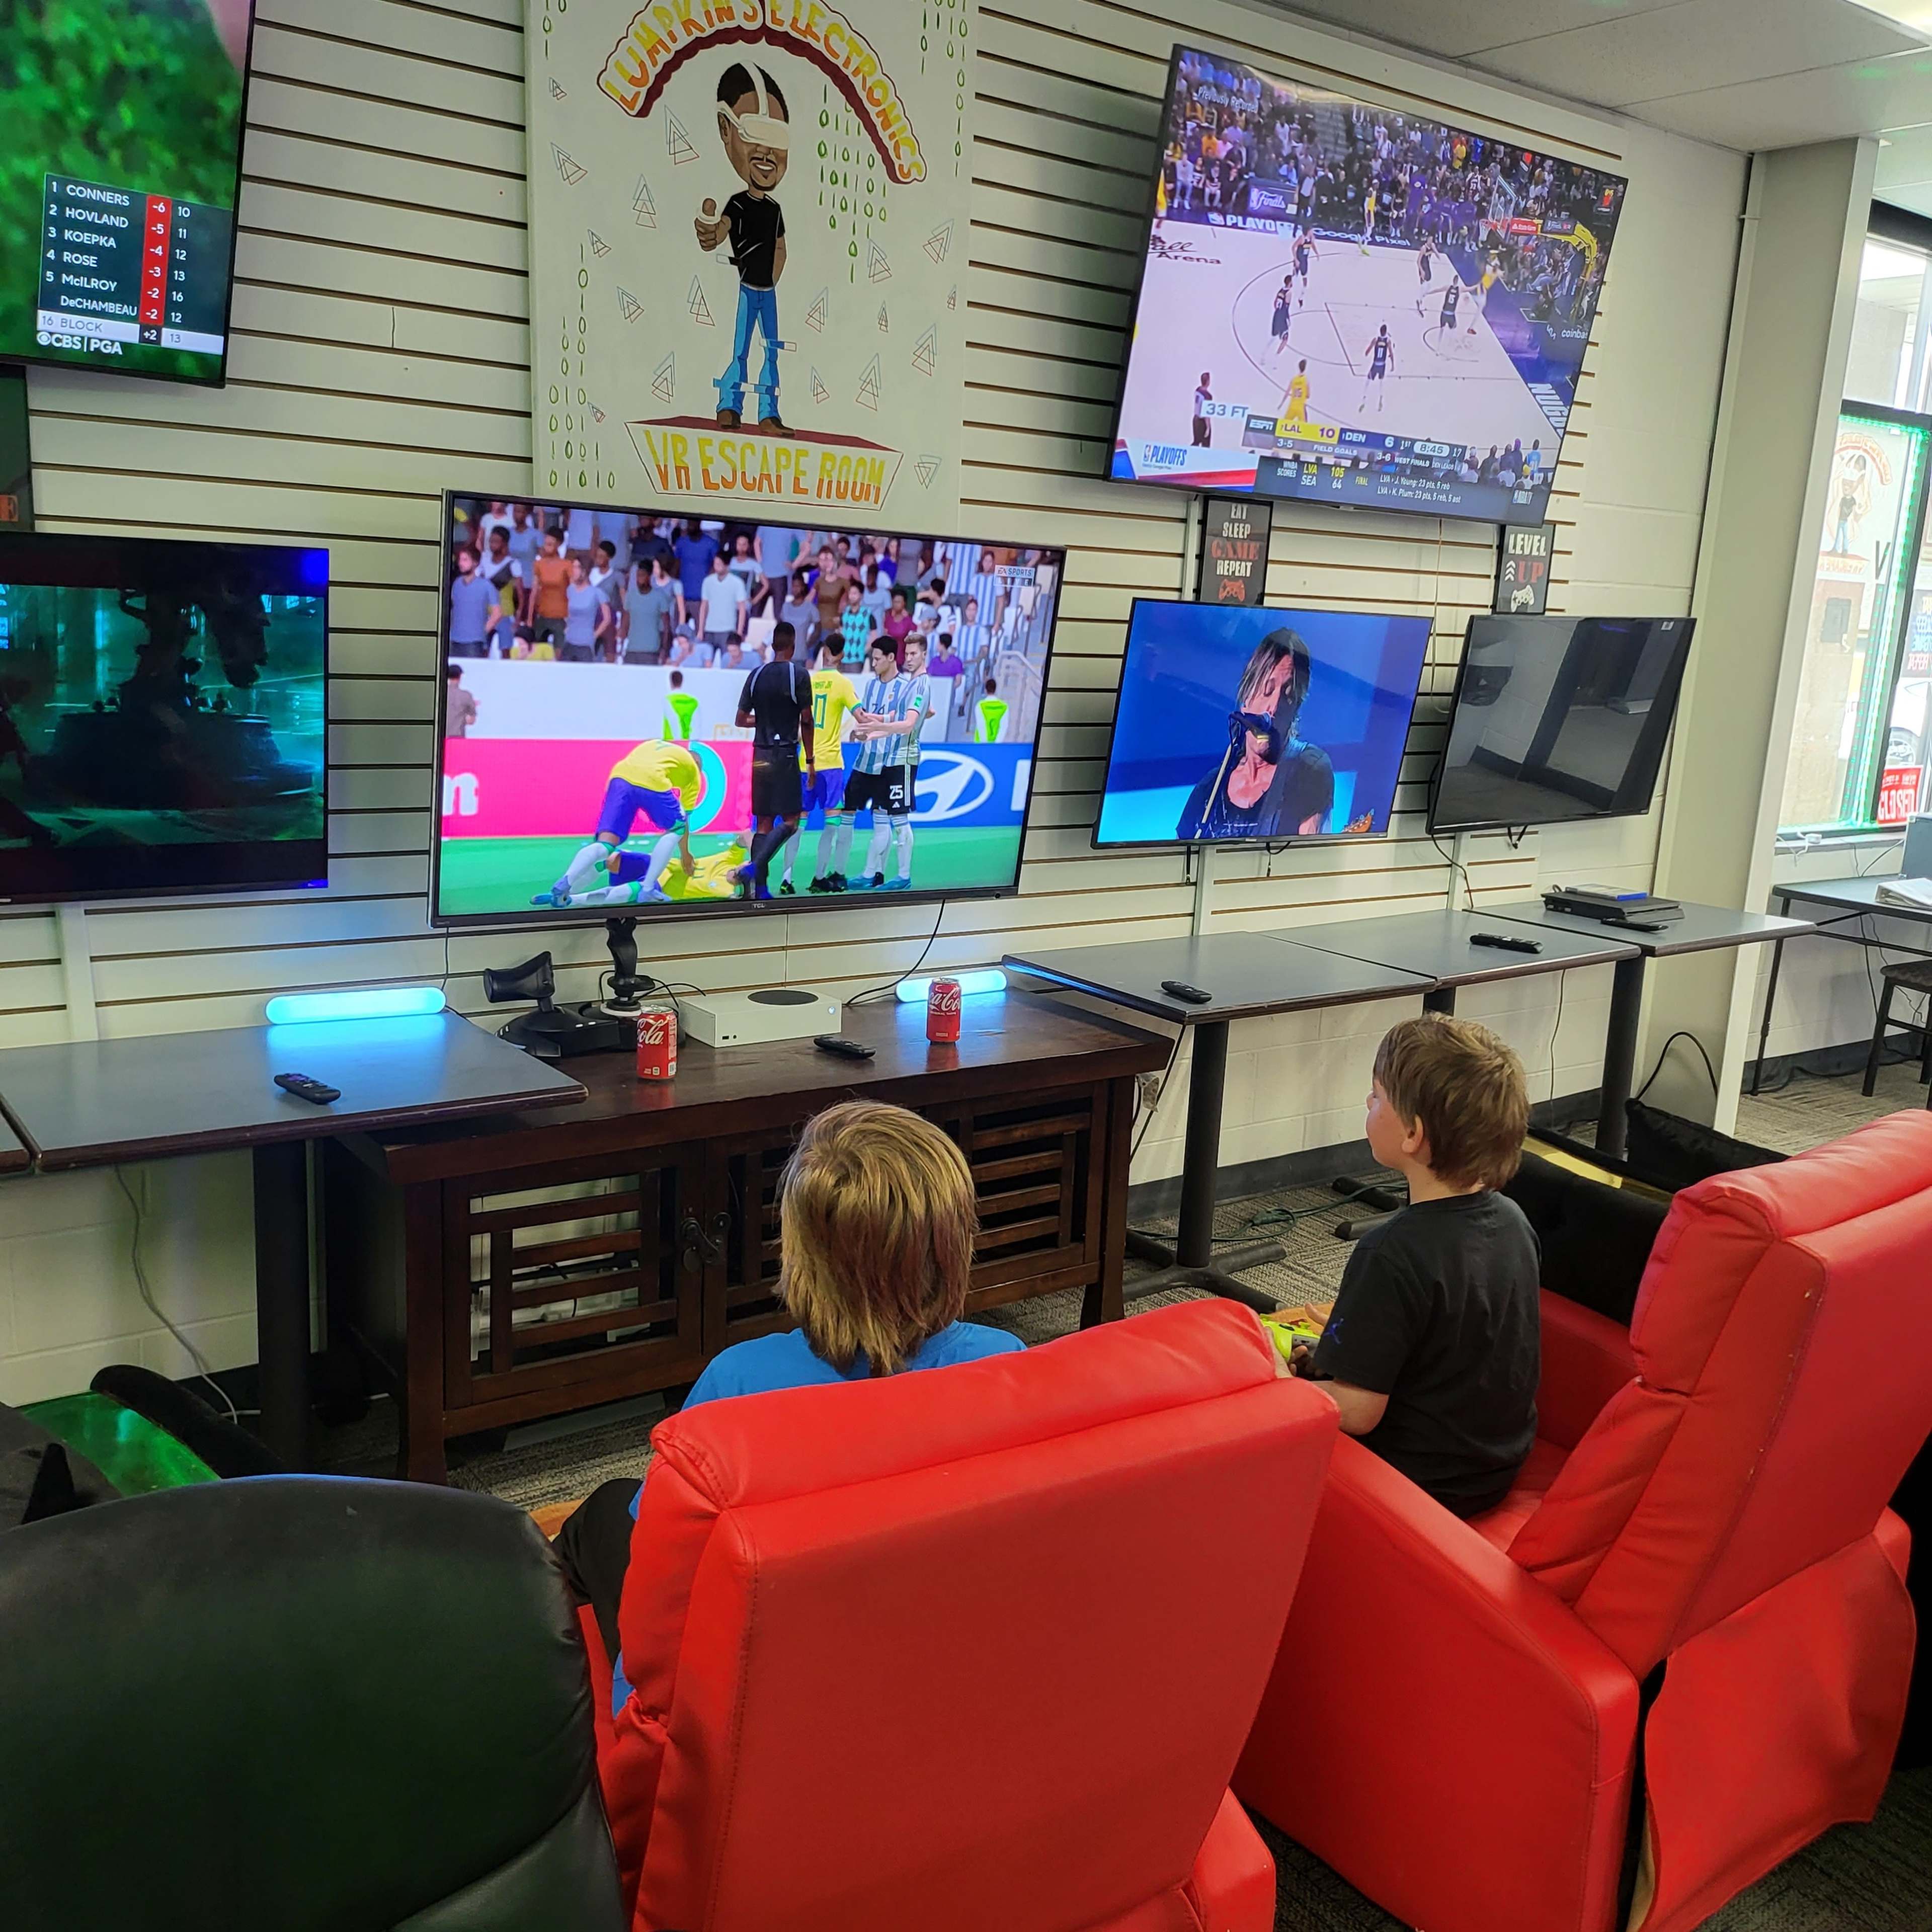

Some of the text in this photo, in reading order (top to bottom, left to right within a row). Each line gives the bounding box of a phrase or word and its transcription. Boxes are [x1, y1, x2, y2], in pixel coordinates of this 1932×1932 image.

[52, 181, 190, 217] 1 CONNERS -6 10
[49, 204, 187, 239] 2 HOVLAND -5 11
[48, 227, 187, 261] 3 KOEPKA -4 12
[1375, 235, 1411, 246] Pixel
[46, 250, 185, 281] 4 ROSE -3 13
[1157, 252, 1222, 264] Arena
[46, 271, 184, 302] 5 McILROY -2 16
[60, 295, 182, 323] DeCHAMBEAU -2 12
[42, 315, 181, 344] 16 BLOCK +2 13
[1206, 404, 1249, 417] 33 FT
[1249, 419, 1273, 430] ESPN
[1283, 423, 1302, 433] LAL
[1319, 428, 1335, 438] 10
[1277, 439, 1293, 448] 3-5
[1334, 447, 1357, 455] GOALS
[1345, 432, 1365, 442] DEN
[1385, 437, 1394, 447] 6
[1420, 444, 1443, 454] 8:45
[1453, 448, 1462, 457] 17
[1150, 445, 1187, 466] PLAYOFFS
[1377, 453, 1391, 461] 3-6
[1410, 459, 1429, 467] FINALS
[644, 429, 886, 505] VR ESCAPE ROOM
[1283, 461, 1345, 477] WNBA LVA 105
[1277, 468, 1368, 489] SCORES SEA 64 FINAL
[1380, 474, 1390, 483] LVA
[1378, 486, 1388, 495] LVA
[1414, 491, 1421, 499] 23
[1231, 503, 1248, 520] EAT
[1223, 522, 1251, 539] SLEEP
[1212, 539, 1260, 559] GAME
[1508, 533, 1546, 556] LEVEL
[1008, 568, 1031, 577] SPORTS
[1217, 559, 1252, 577] REPEAT
[1518, 560, 1544, 583] UP
[890, 785, 903, 799] 25
[1878, 788, 1916, 820] CLOSED
